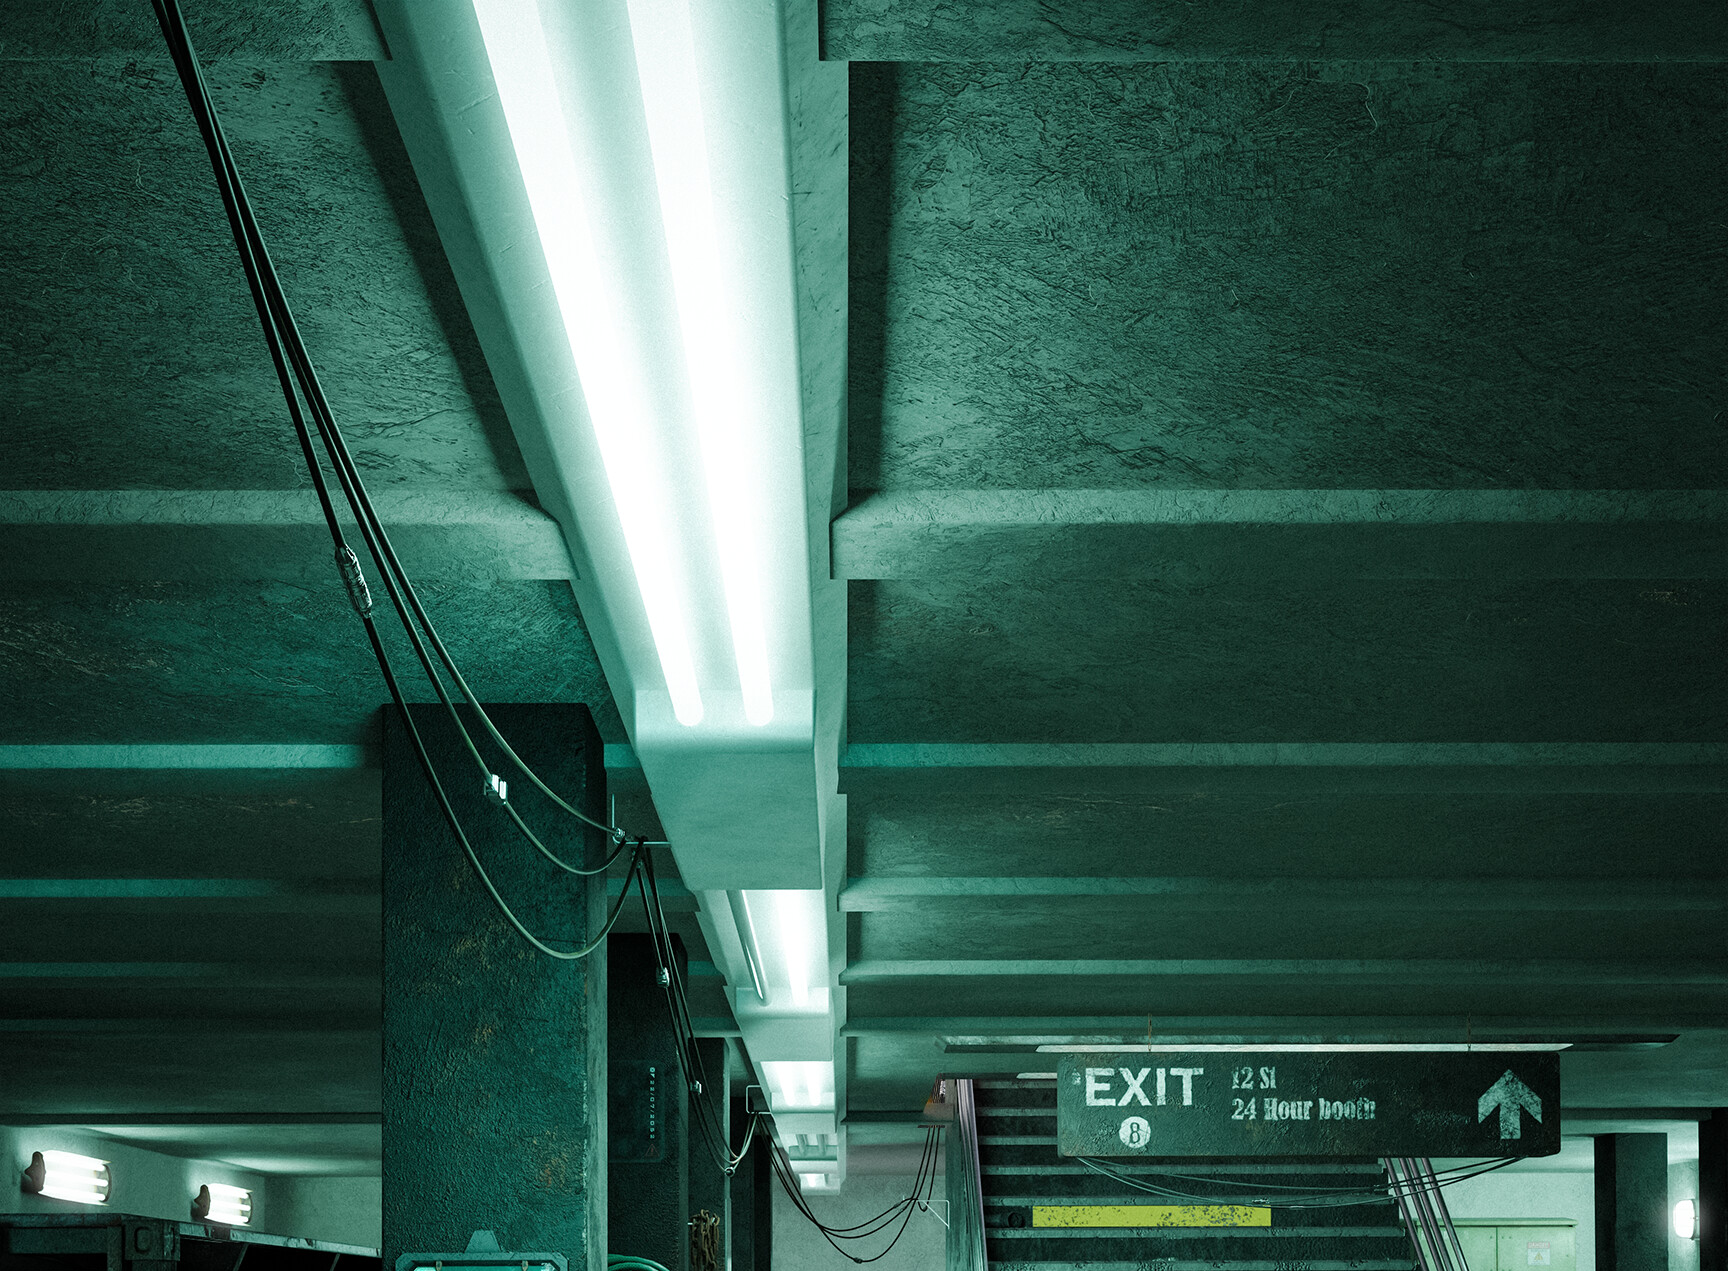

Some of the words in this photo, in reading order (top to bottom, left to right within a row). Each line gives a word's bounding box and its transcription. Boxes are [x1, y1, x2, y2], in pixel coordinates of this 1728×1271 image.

[1085, 1067, 1204, 1106] EXIT
[1231, 1066, 1254, 1090] 12
[1231, 1098, 1257, 1121] 24
[1263, 1098, 1313, 1121] Hour
[1318, 1096, 1376, 1121] booth
[1129, 1122, 1141, 1144] 8
